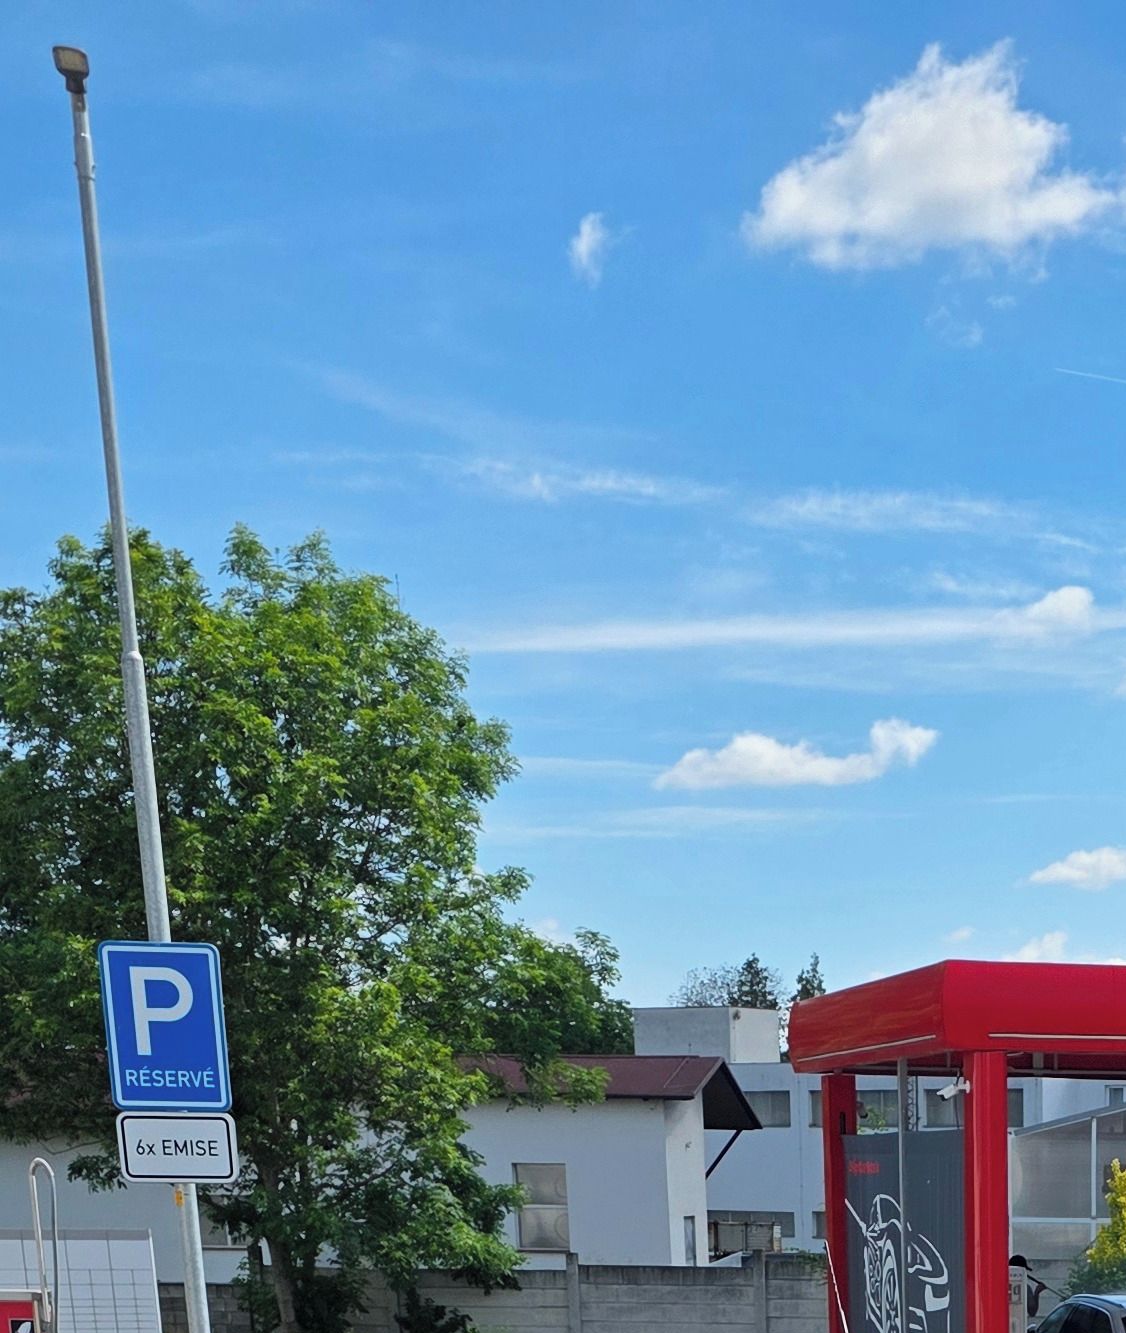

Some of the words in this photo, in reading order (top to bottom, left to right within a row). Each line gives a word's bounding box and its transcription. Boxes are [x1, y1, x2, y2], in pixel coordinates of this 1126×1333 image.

[129, 966, 194, 1056] P
[125, 1065, 215, 1088] RÉSERVÉ
[136, 1139, 156, 1156] 6x
[162, 1139, 219, 1157] EMISE
